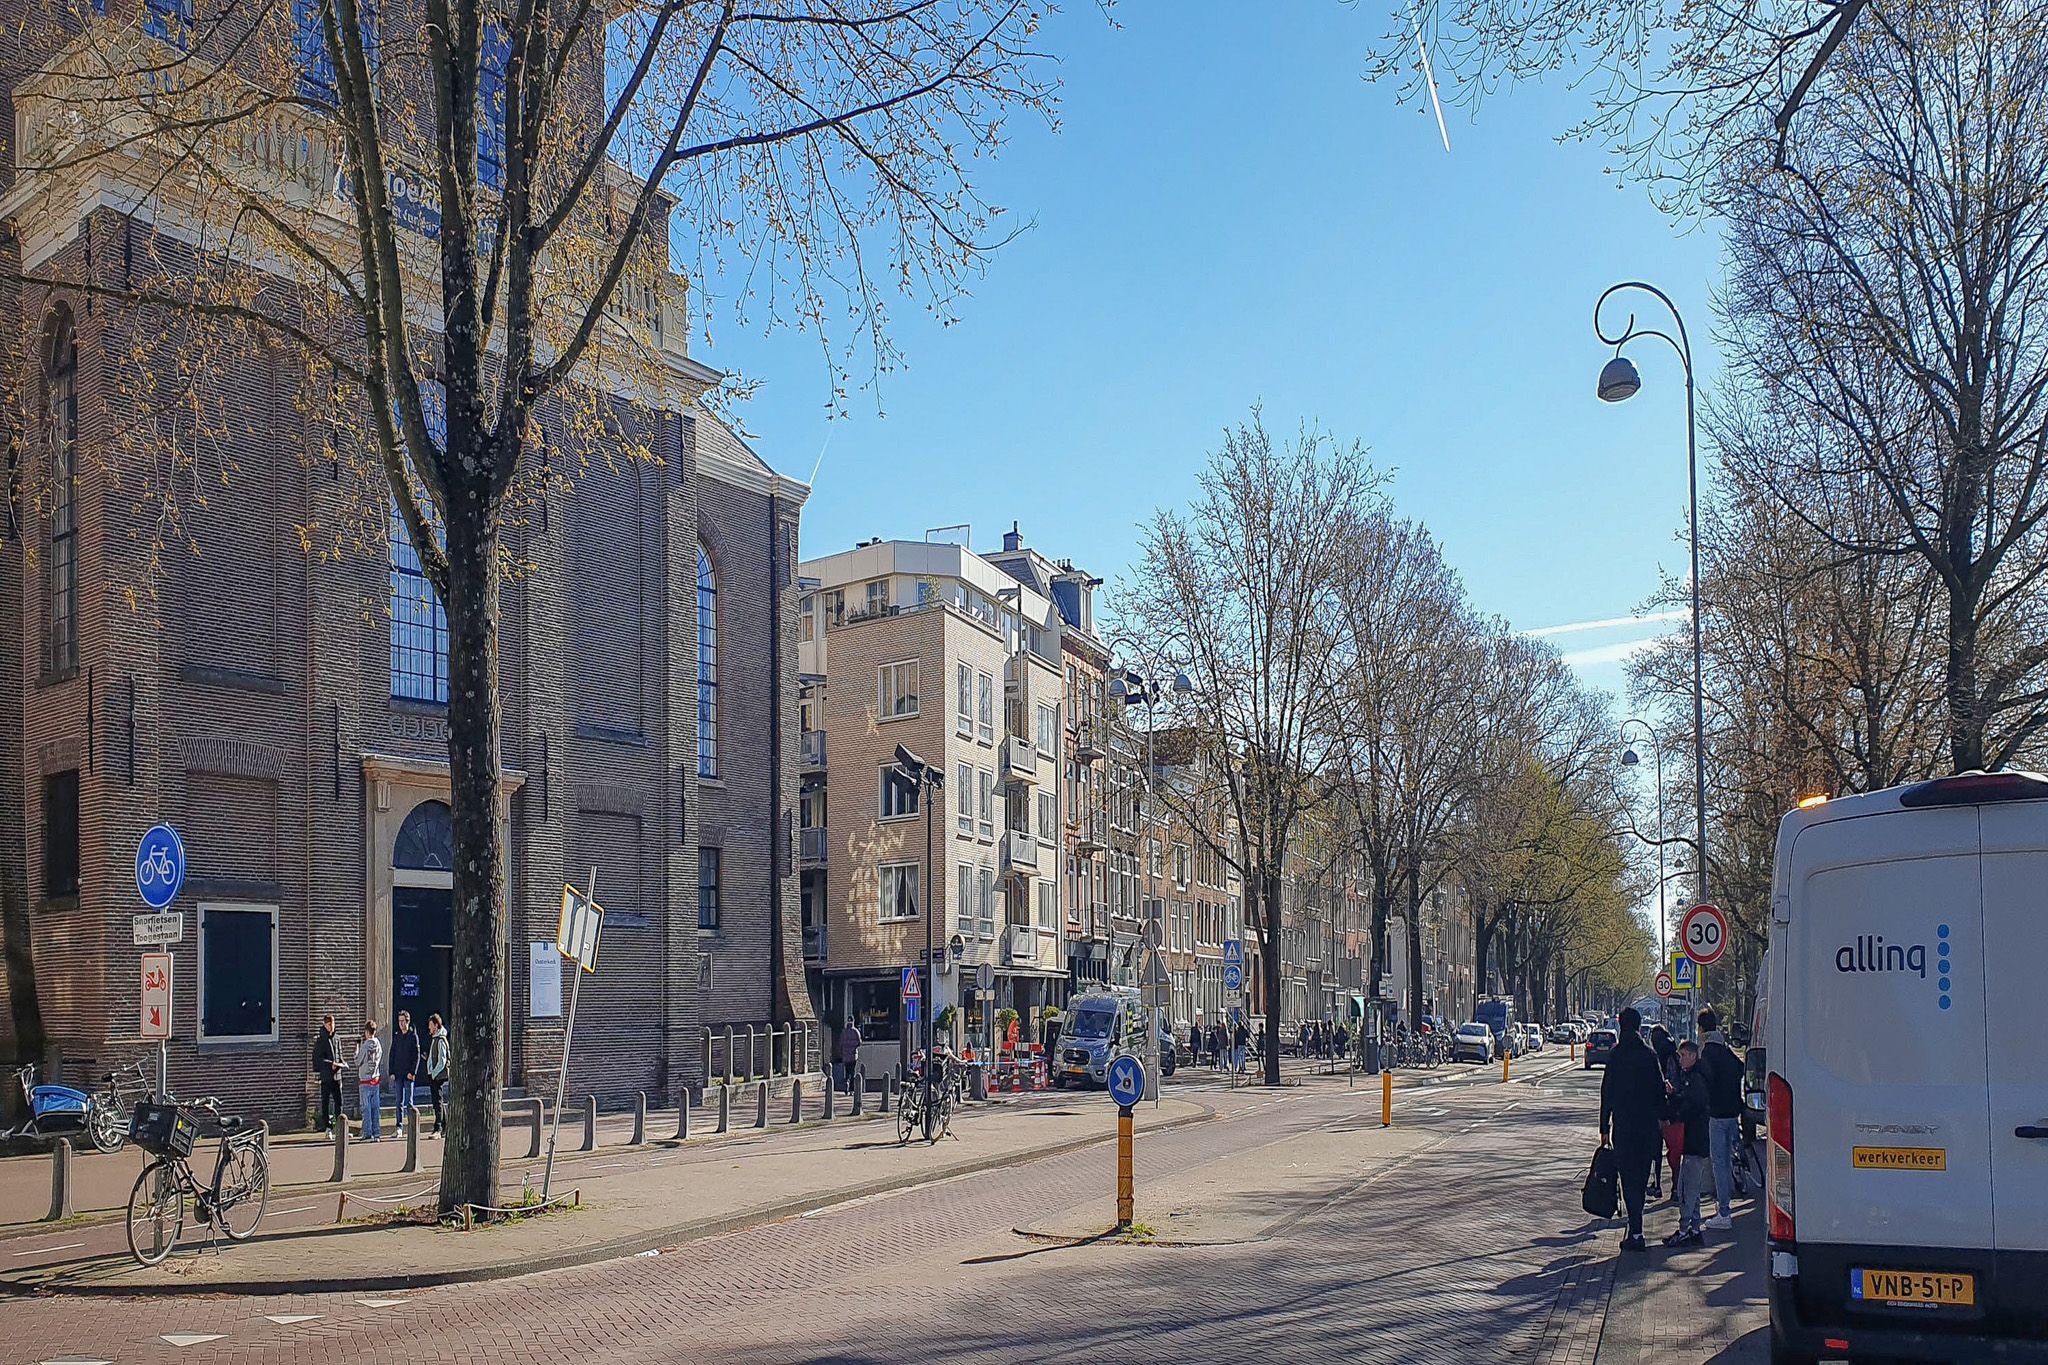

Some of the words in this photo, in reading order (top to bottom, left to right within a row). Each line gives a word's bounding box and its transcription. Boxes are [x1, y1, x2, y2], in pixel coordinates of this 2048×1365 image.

[134, 916, 177, 926] Snorfietsen
[147, 924, 163, 933] Niet
[1690, 922, 1720, 945] 30
[135, 931, 178, 943] Toegestaan
[1835, 934, 1926, 979] allinq
[1658, 980, 1670, 990] 30
[1858, 1151, 1941, 1165] werkverkeer
[1853, 1286, 1862, 1294] NL
[1871, 1274, 1963, 1299] VNB-51-P
